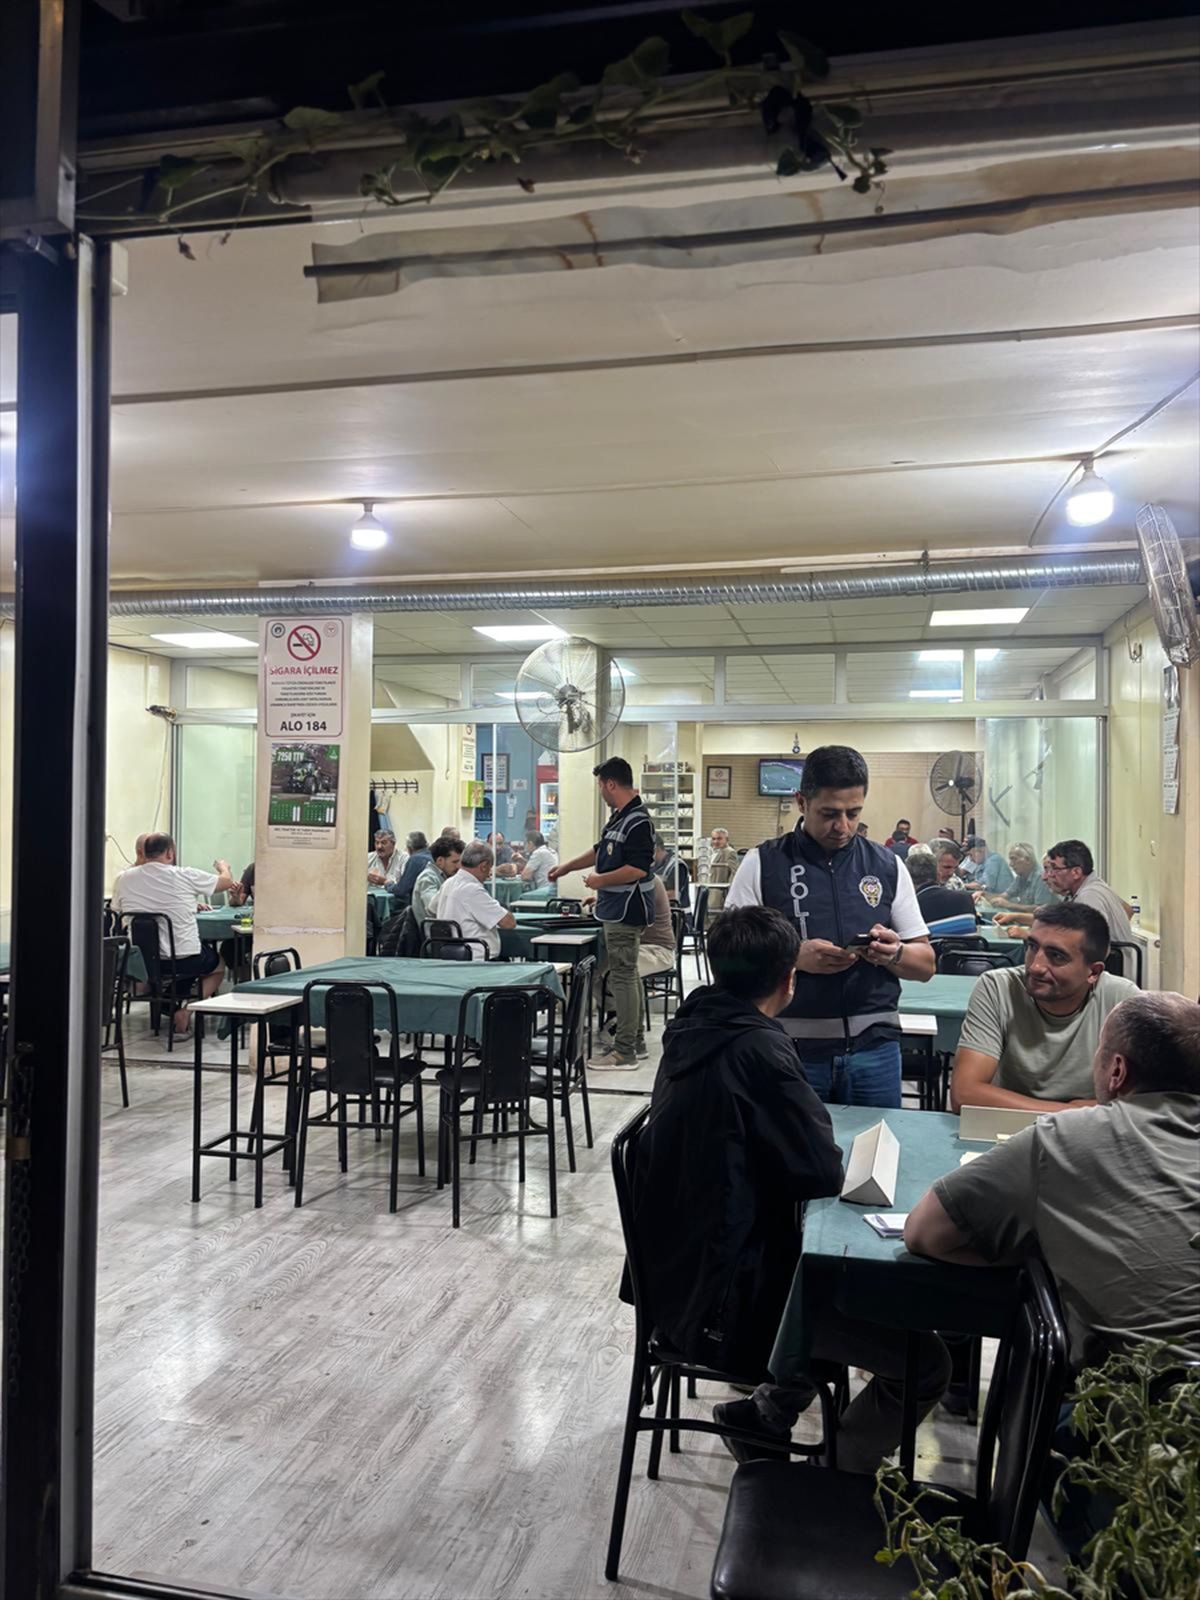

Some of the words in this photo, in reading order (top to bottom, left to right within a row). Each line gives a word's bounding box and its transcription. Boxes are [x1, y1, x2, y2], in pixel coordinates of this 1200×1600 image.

[270, 665, 302, 676] SİGARA
[303, 665, 339, 677] İÇİLMEZ
[280, 720, 303, 731] ALO
[306, 720, 327, 731] 184
